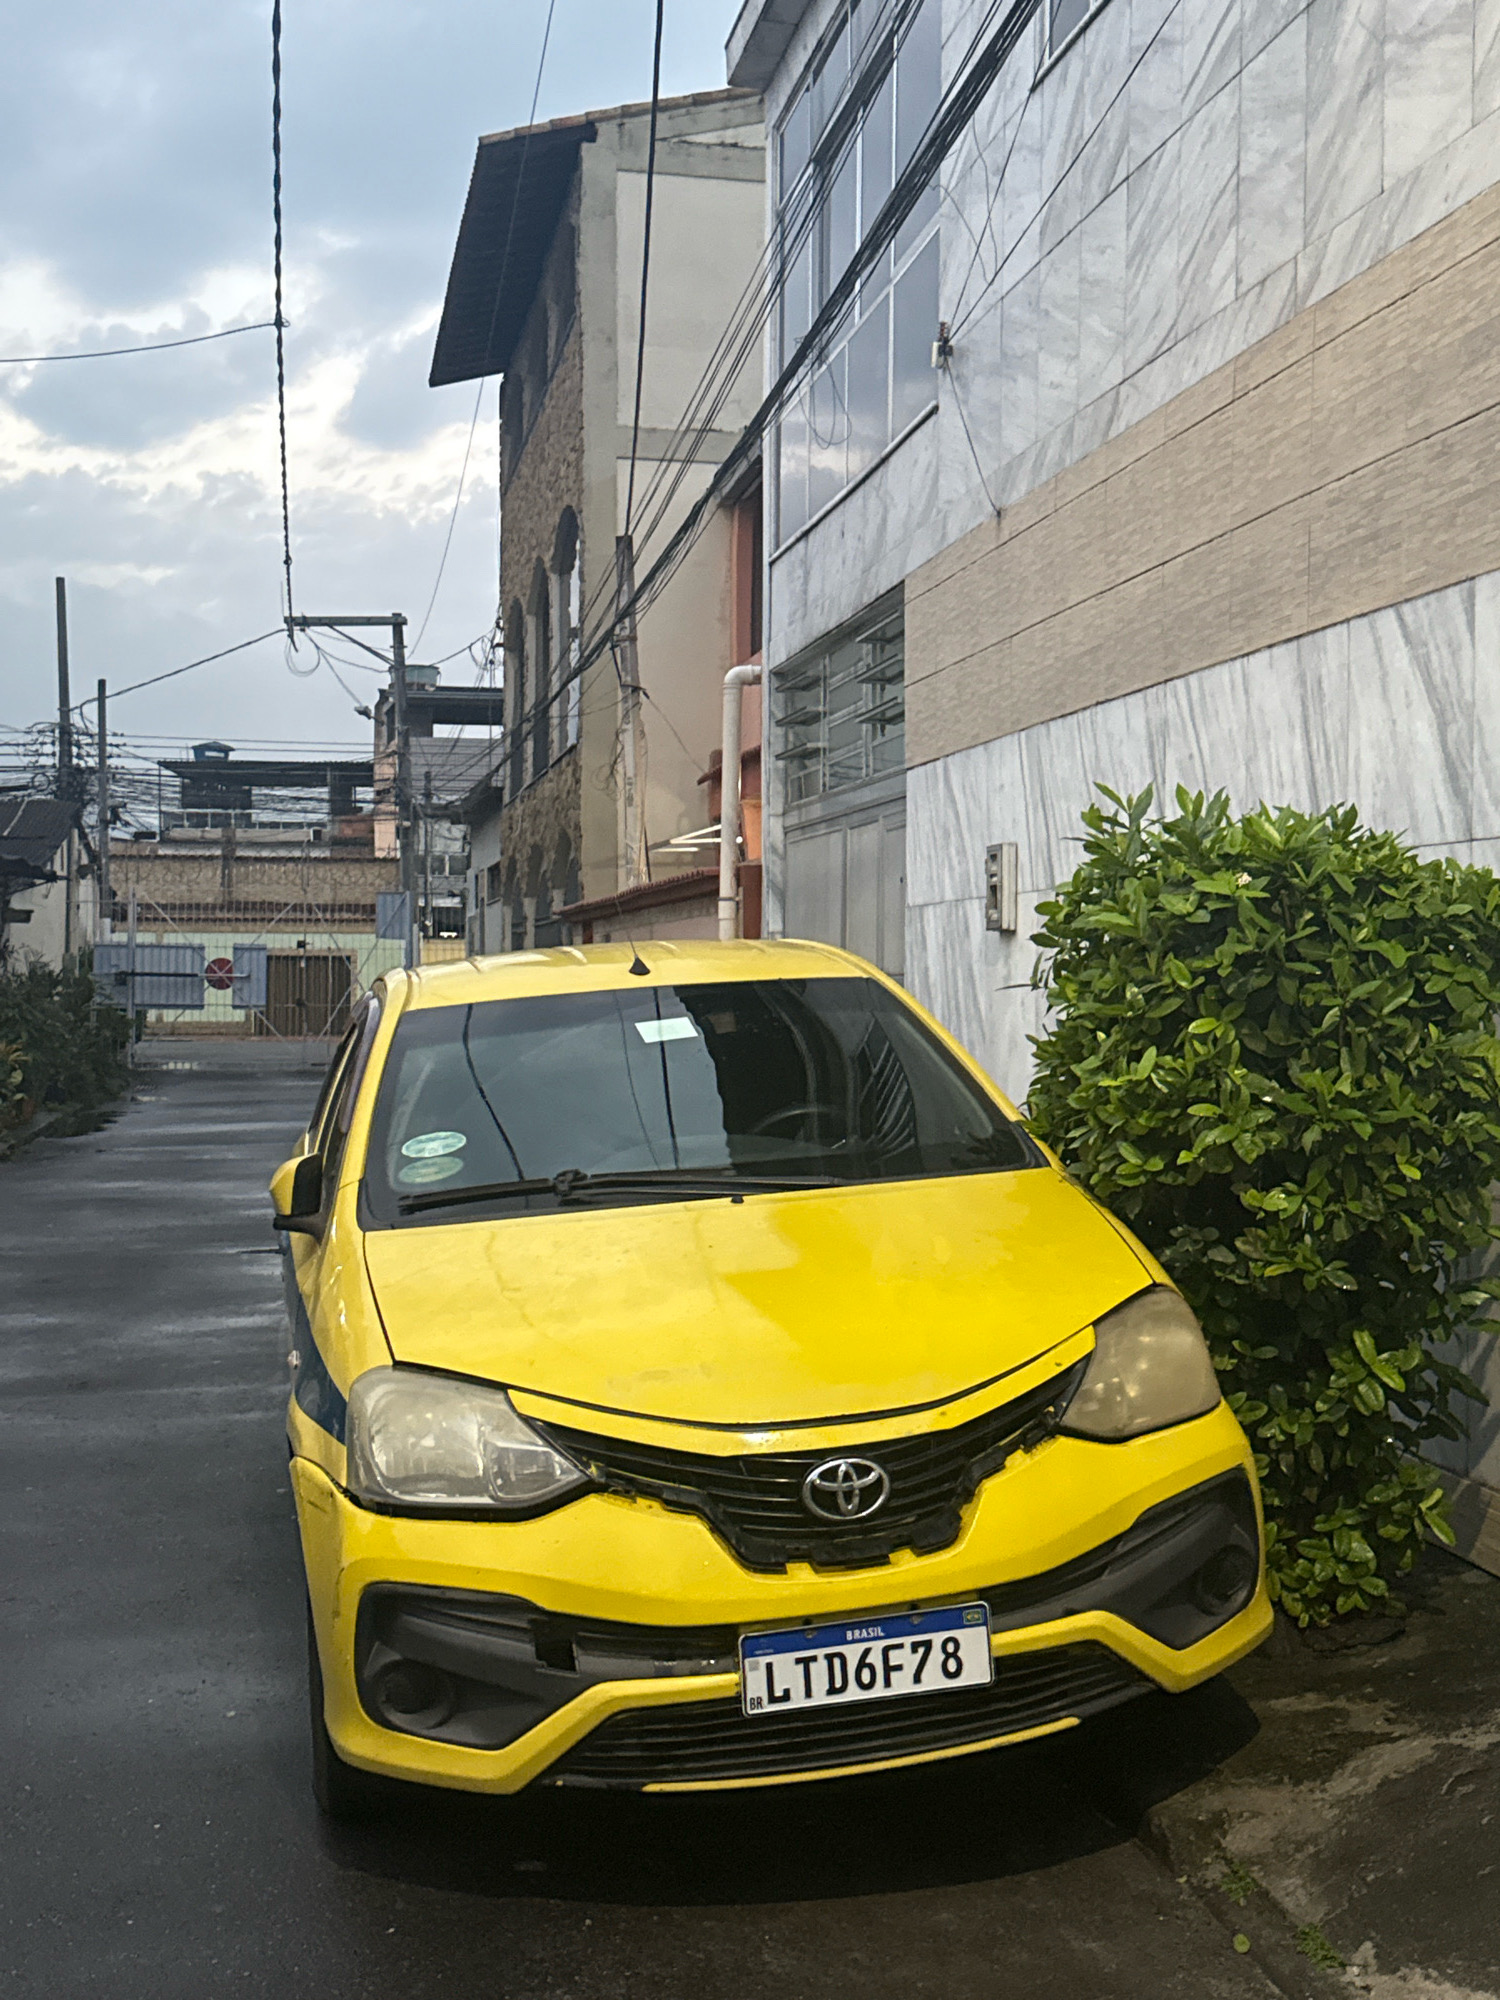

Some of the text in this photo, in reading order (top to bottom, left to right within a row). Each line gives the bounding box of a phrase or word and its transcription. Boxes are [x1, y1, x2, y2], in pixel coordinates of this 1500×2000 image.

[845, 1626, 885, 1641] BRASIL
[765, 1636, 963, 1705] LTD6F78
[749, 1696, 764, 1711] BR
